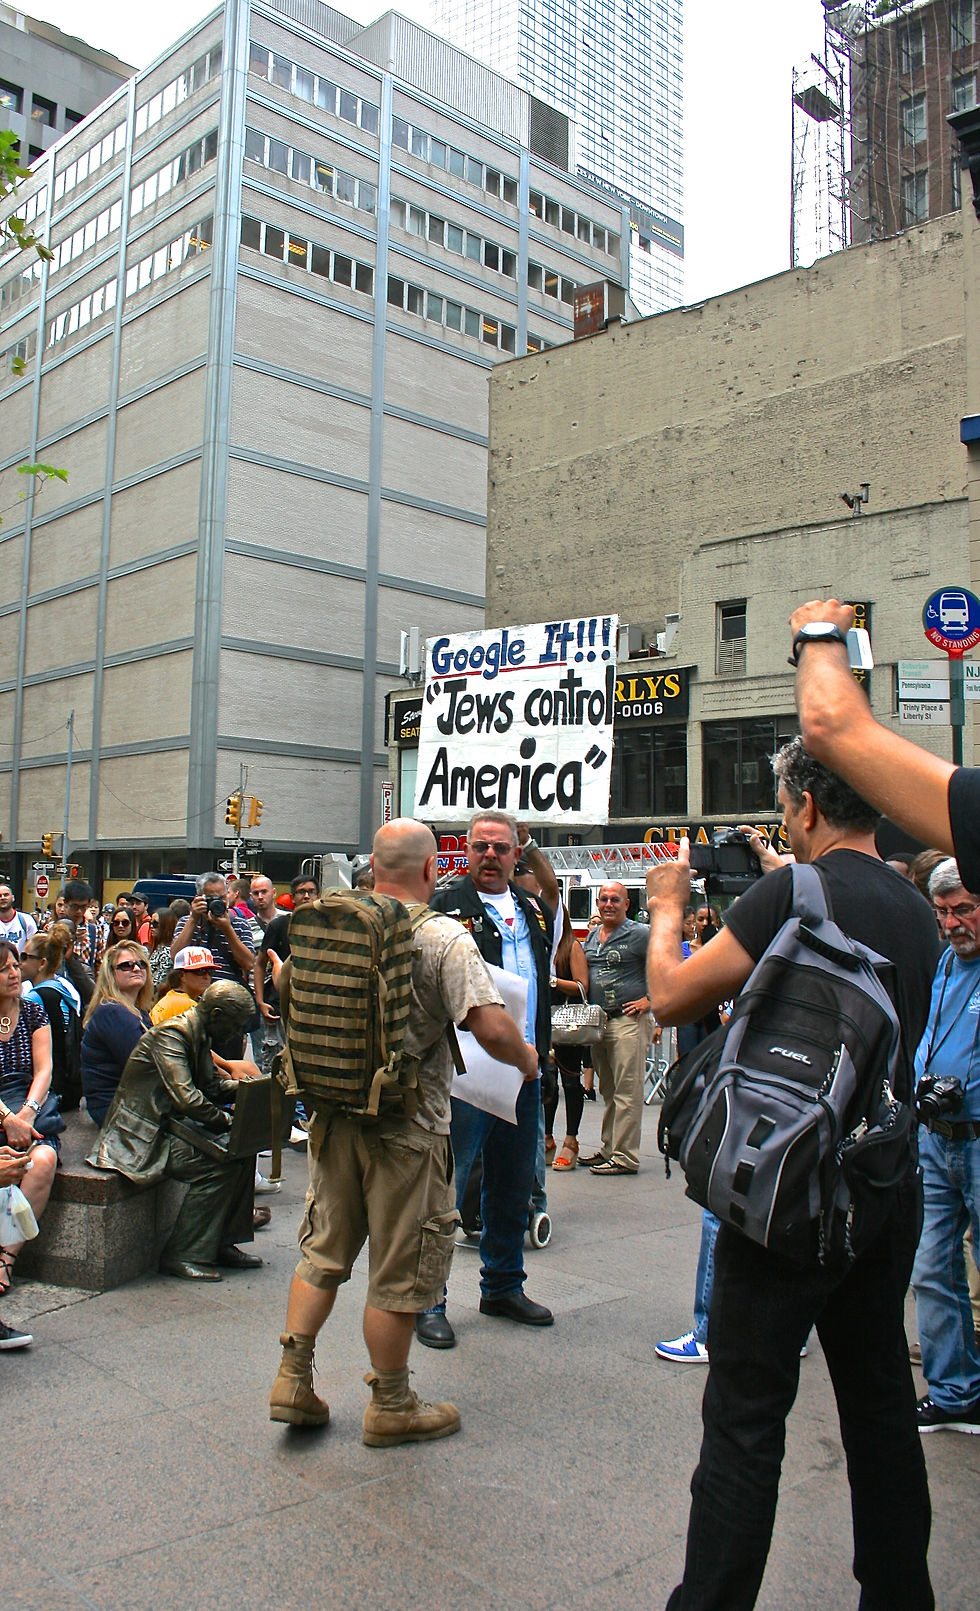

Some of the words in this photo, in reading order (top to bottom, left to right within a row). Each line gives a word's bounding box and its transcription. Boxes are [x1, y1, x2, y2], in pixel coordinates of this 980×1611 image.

[602, 181, 616, 193] NEW
[616, 188, 631, 203] YORK
[635, 202, 668, 224] DOWNTOWN
[431, 630, 526, 680] Google
[539, 617, 611, 663] It!!!
[930, 631, 942, 643] NO
[942, 632, 980, 649] STANDING
[524, 665, 615, 727] control
[614, 674, 681, 703] RLYS
[616, 701, 663, 718] -0006
[921, 704, 937, 712] Place
[400, 727, 421, 739] SEAT
[384, 790, 392, 823] PIZZ
[769, 1046, 812, 1065] FUEL
